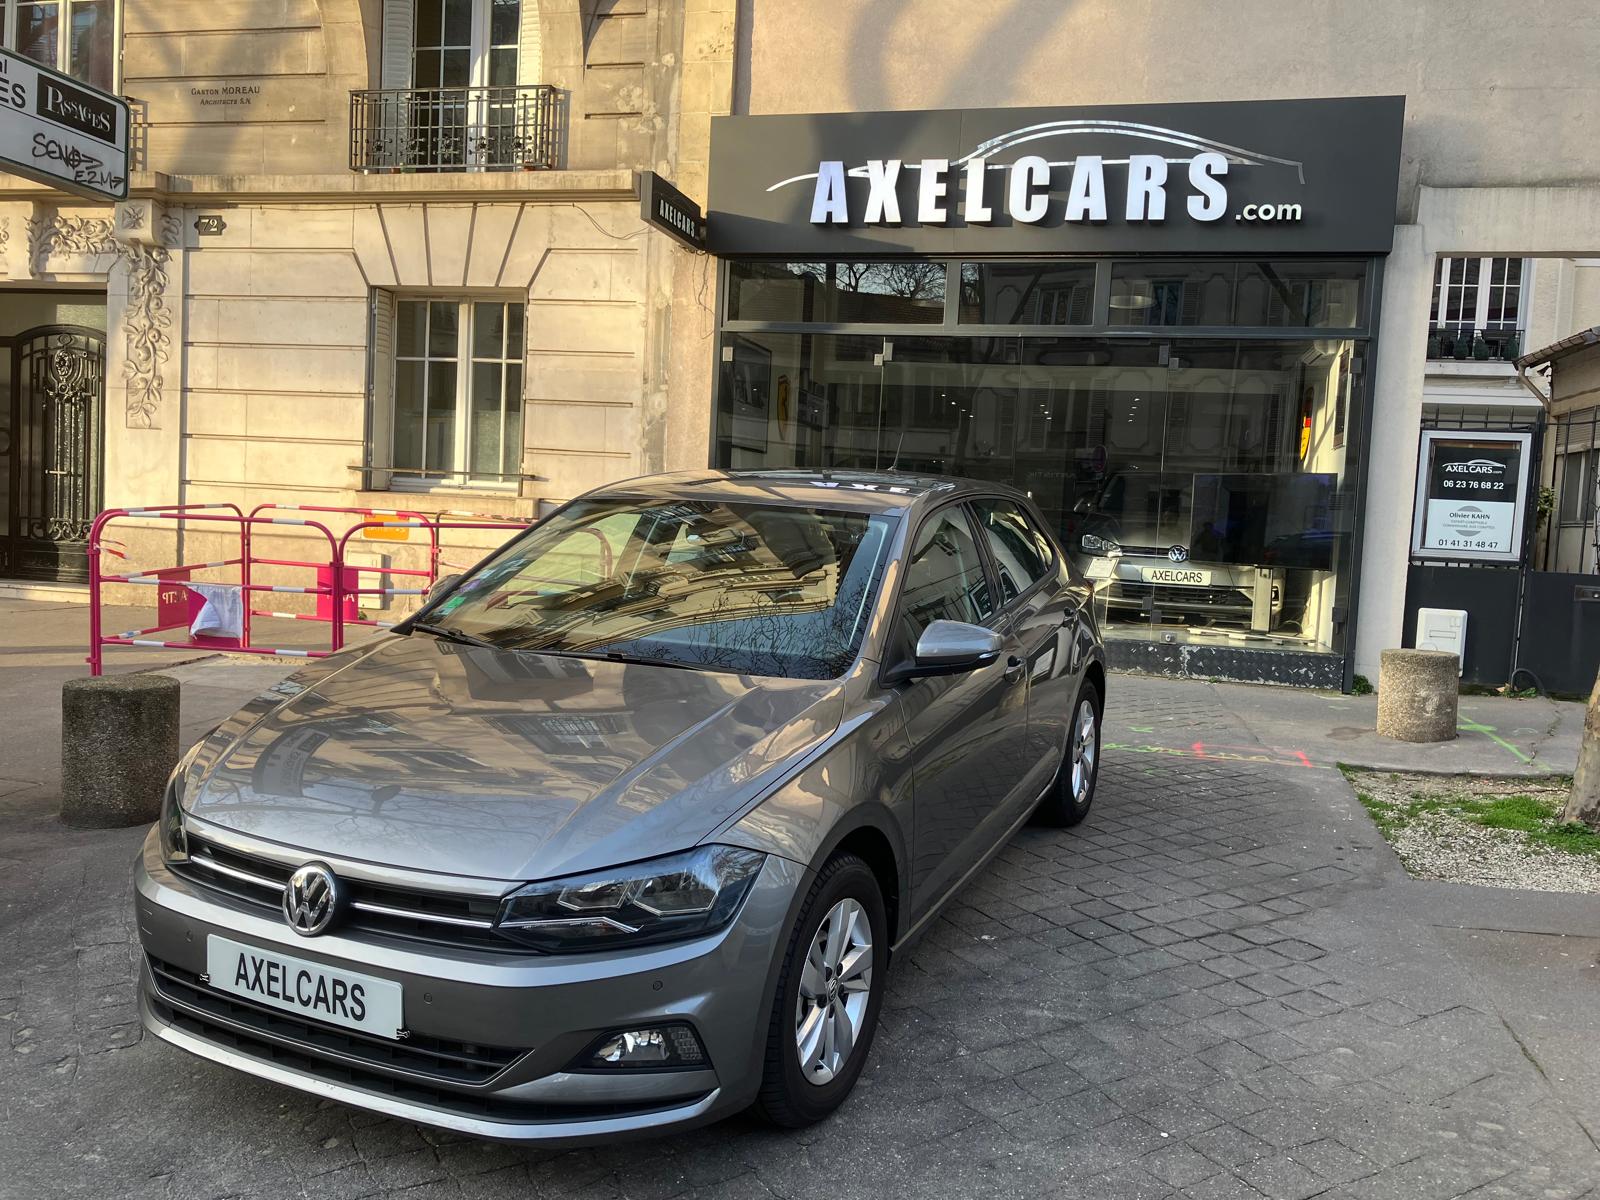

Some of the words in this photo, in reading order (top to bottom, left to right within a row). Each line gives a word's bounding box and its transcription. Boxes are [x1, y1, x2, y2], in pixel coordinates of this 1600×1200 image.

[222, 86, 260, 94] MOREAU
[809, 153, 1229, 223] AXELCARS
[1236, 201, 1302, 221] .com
[660, 199, 695, 238] AXELCARS
[201, 219, 217, 231] 72
[1443, 480, 1454, 488] 06
[1456, 480, 1466, 488] 23
[1468, 481, 1479, 489] 76
[1481, 481, 1491, 489] 68
[1493, 482, 1504, 490] 22
[1463, 540, 1472, 548] 31
[1488, 541, 1498, 549] 47
[1151, 570, 1203, 583] AXELCARS
[235, 952, 366, 1022] AXELCARS
